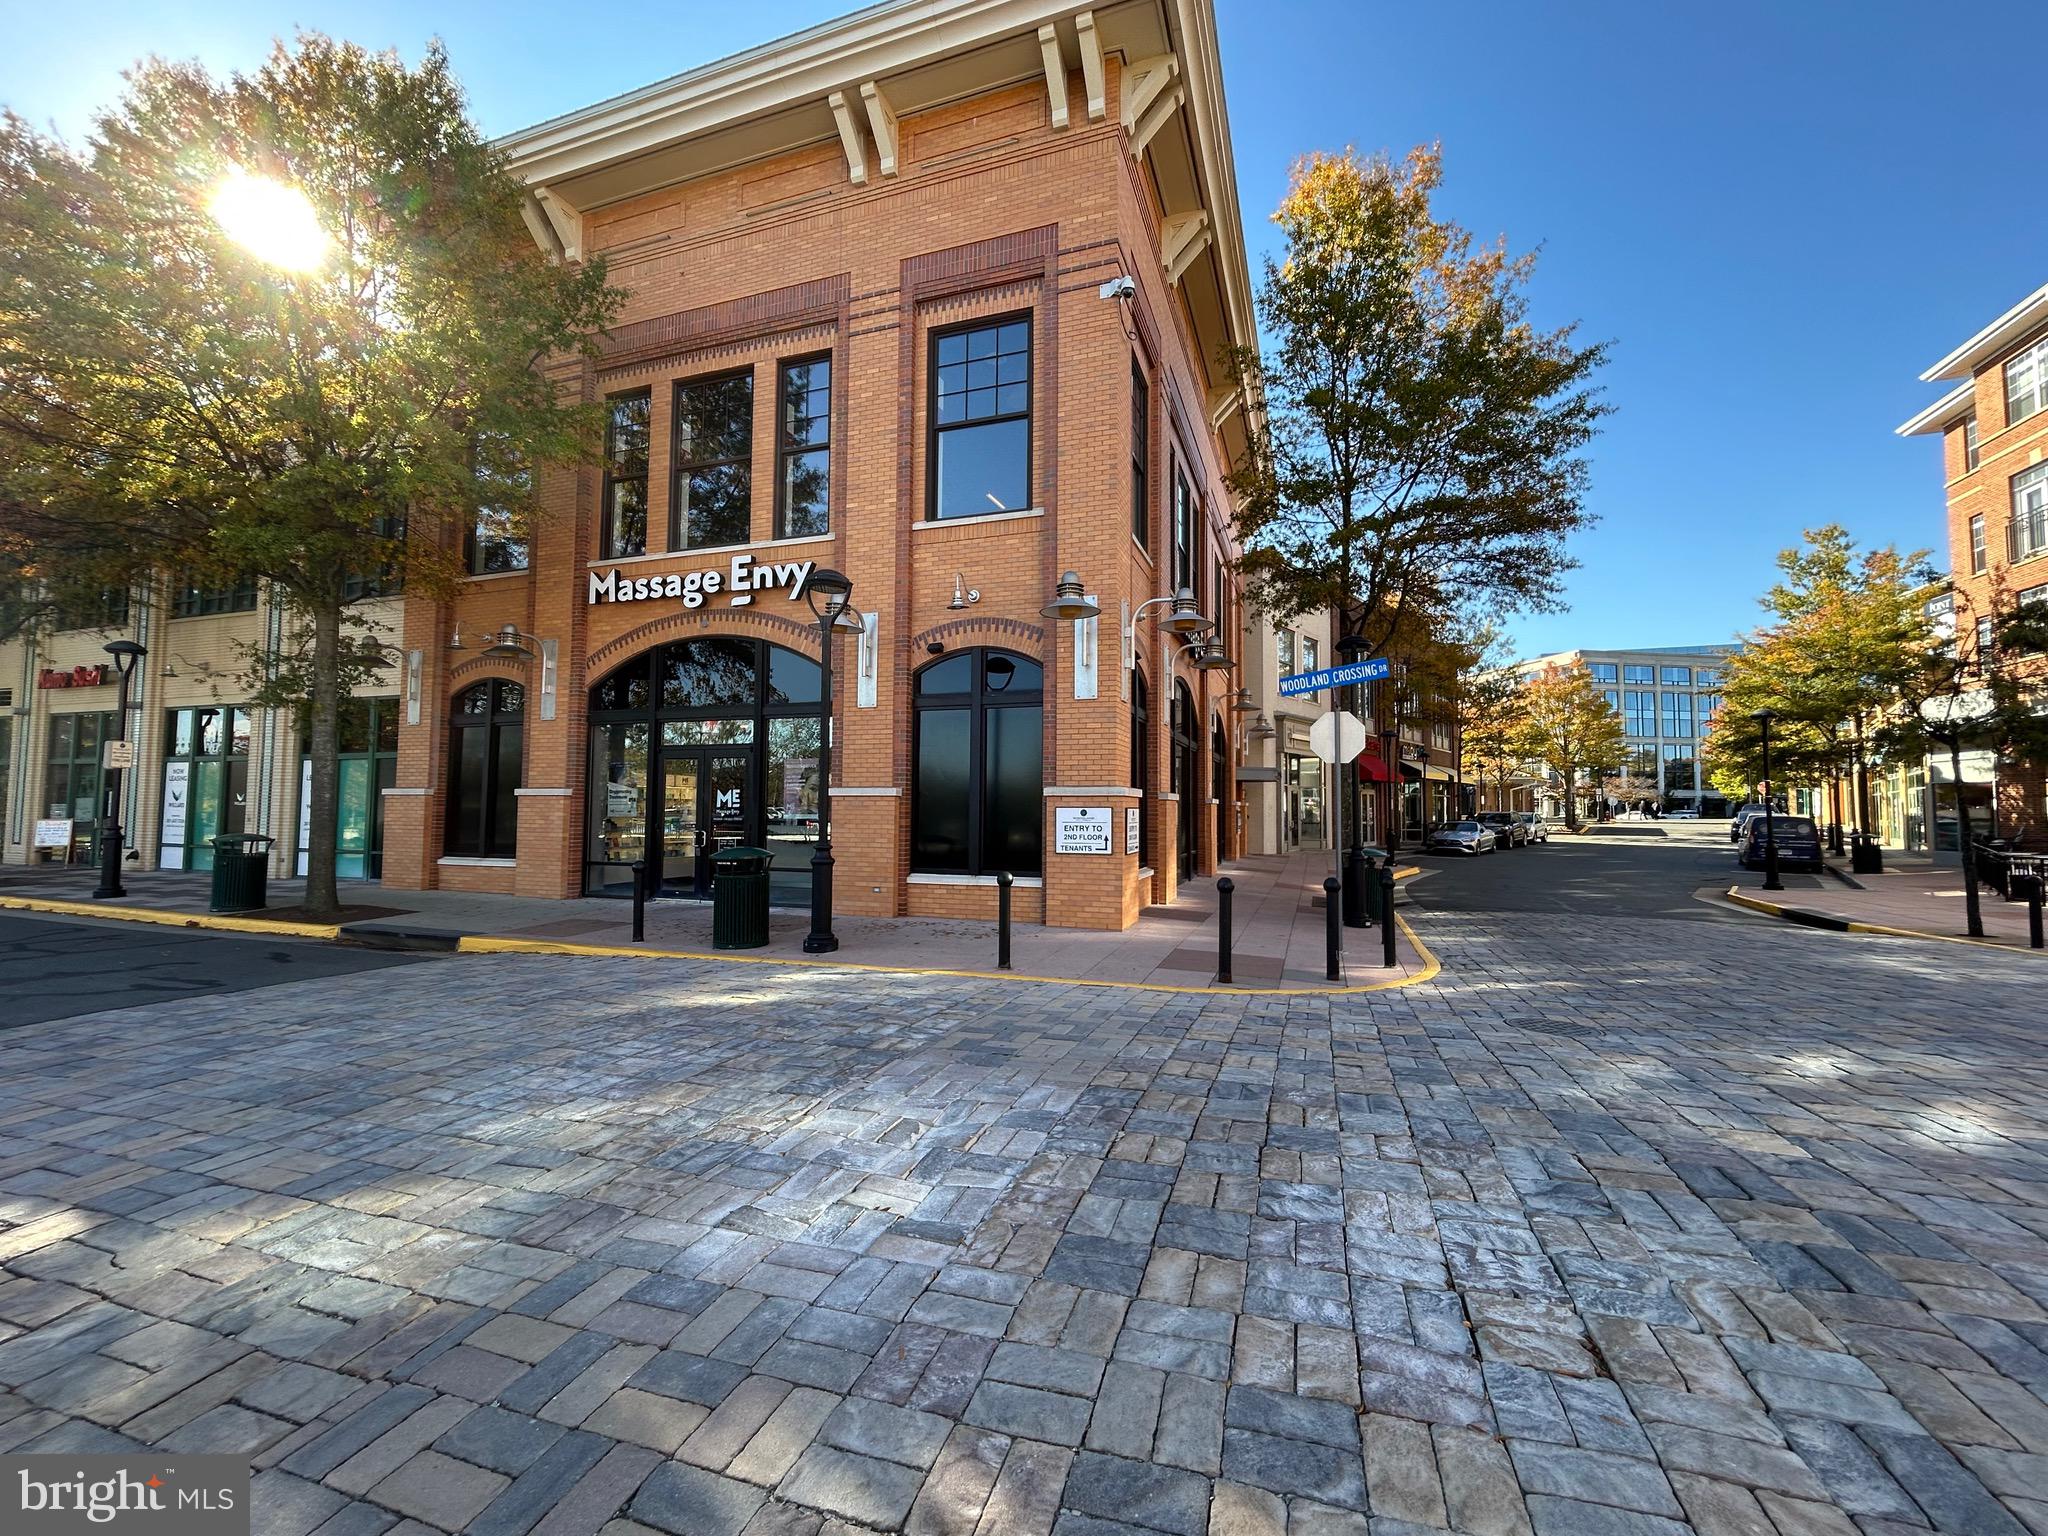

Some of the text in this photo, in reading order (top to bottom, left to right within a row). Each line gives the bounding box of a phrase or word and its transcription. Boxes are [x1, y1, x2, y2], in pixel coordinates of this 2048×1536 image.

[588, 554, 816, 609] Massage Envy
[1280, 663, 1388, 693] WOODLAND CROSSING DR
[716, 788, 741, 808] ME
[1063, 824, 1089, 832] ENTRY
